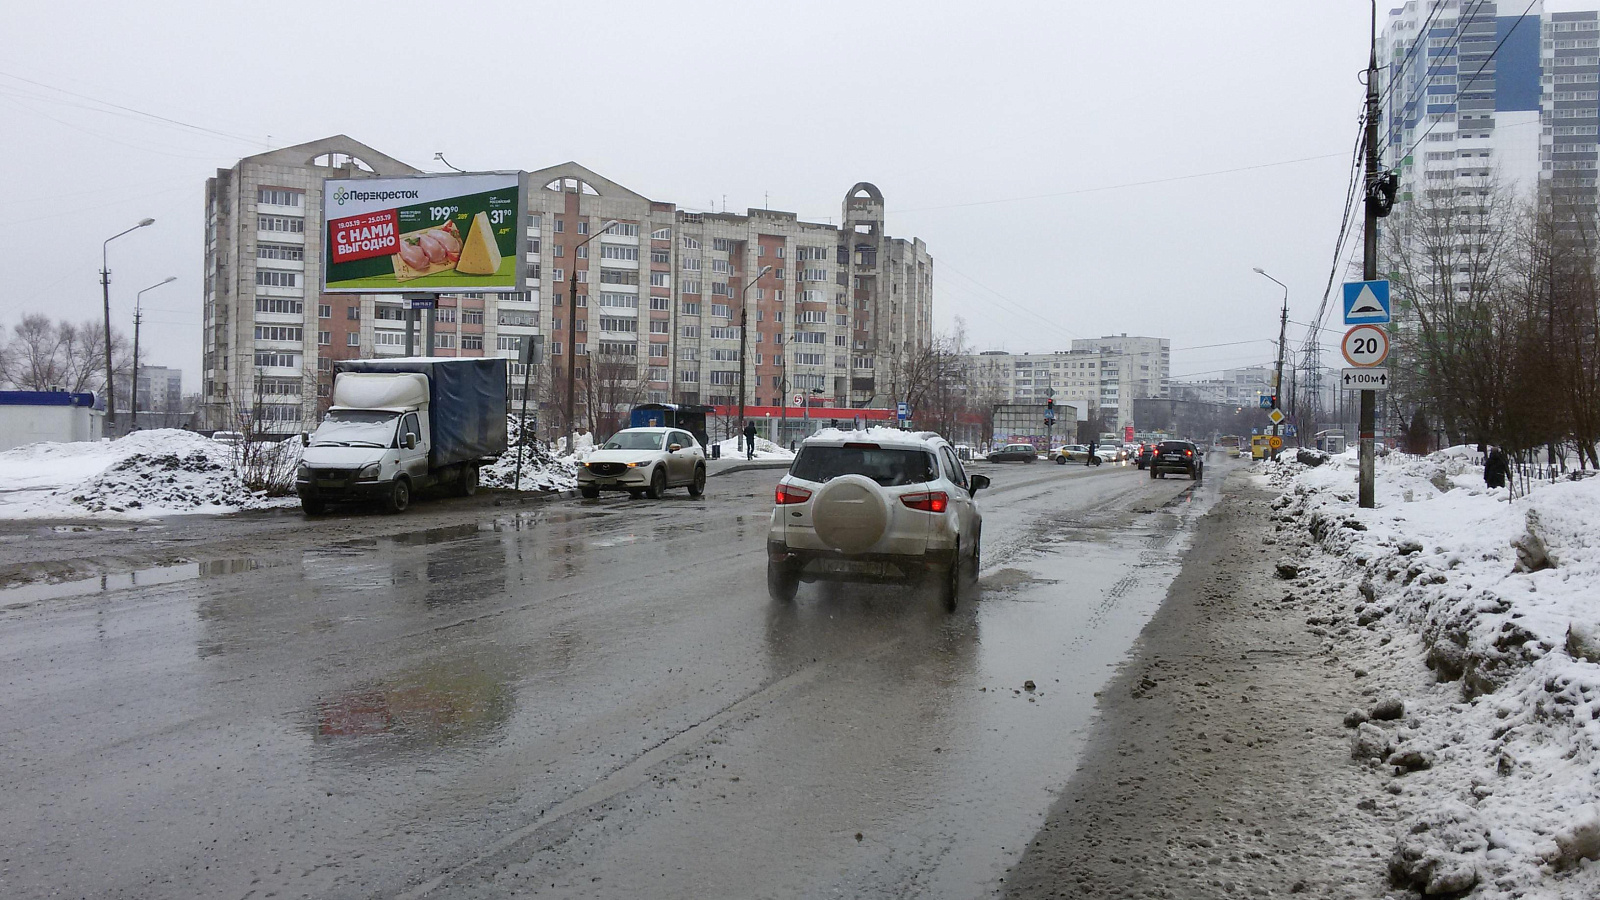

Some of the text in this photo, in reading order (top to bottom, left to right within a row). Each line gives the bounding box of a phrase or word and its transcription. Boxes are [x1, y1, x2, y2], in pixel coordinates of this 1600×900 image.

[350, 190, 419, 202] Перекресток
[368, 213, 391, 224] 25.03.19
[336, 222, 394, 244] С НАМИ
[337, 235, 396, 255] ВЫГОДНО
[1353, 338, 1378, 354] 20
